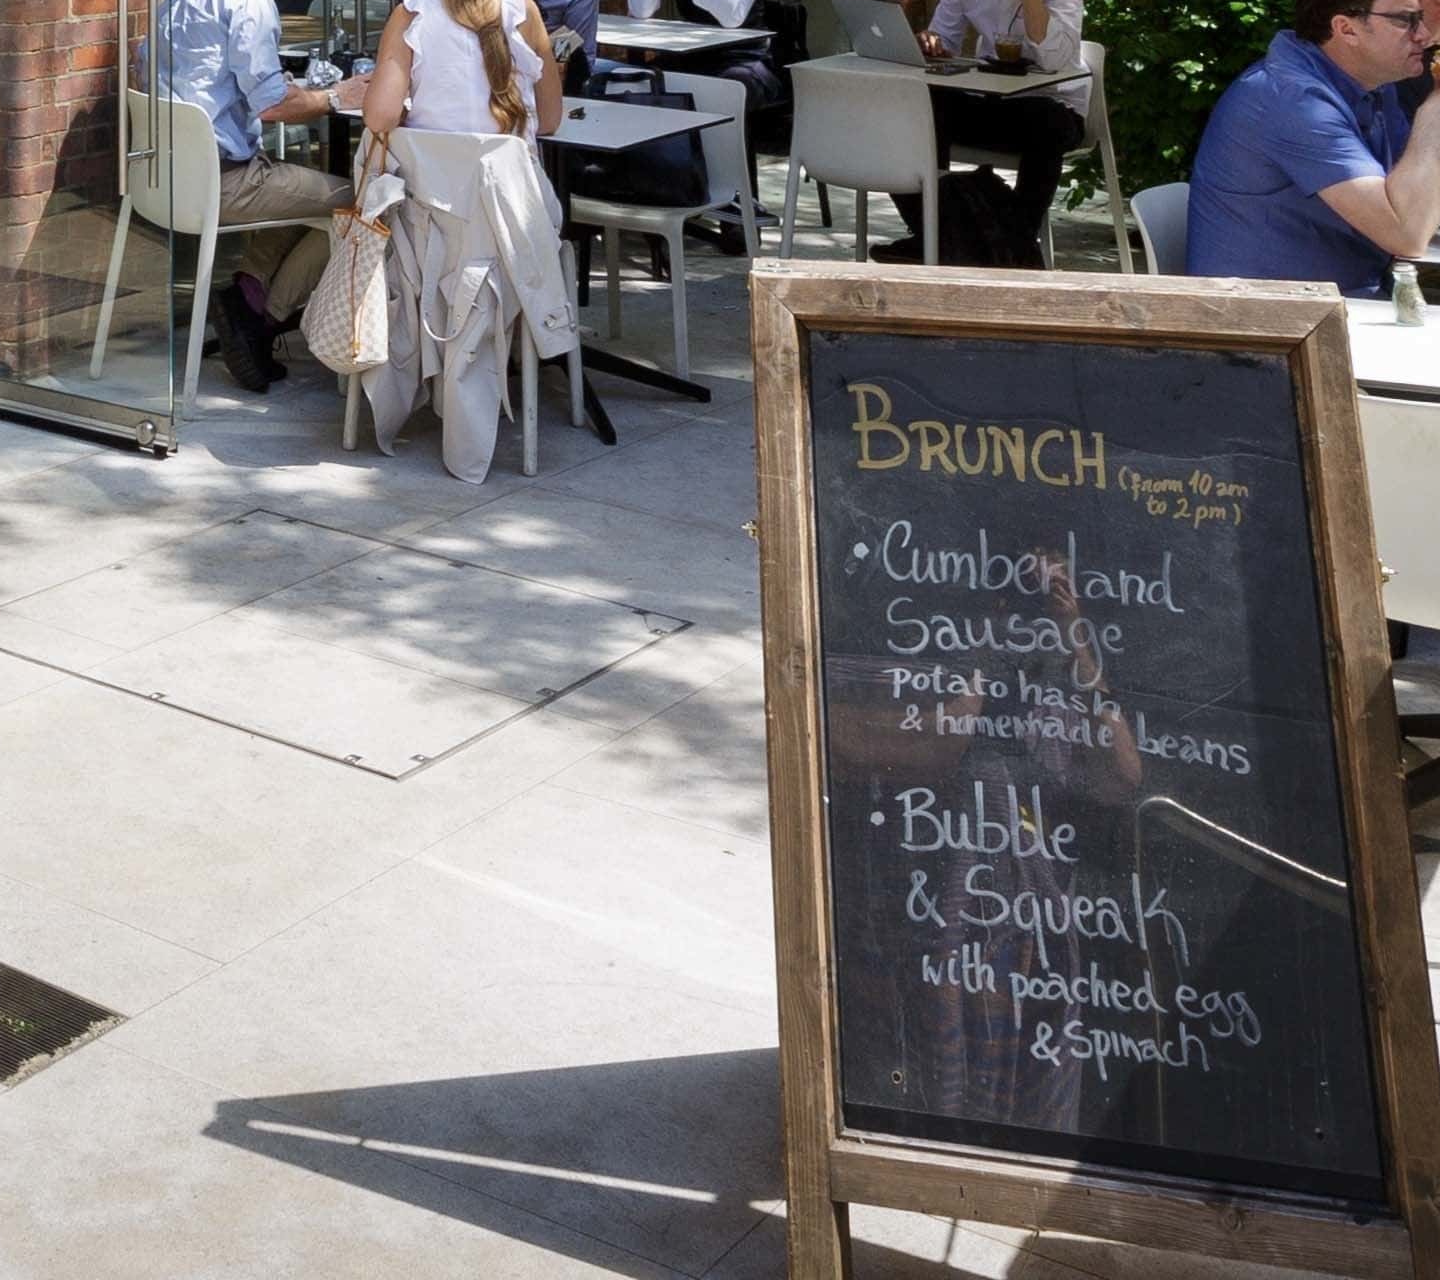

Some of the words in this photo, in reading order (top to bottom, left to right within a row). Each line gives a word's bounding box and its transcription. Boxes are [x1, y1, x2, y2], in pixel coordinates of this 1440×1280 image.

[848, 383, 1107, 489] BRUNCH
[1146, 496, 1168, 516] to
[1173, 499, 1191, 519] 2
[1187, 469, 1211, 498] 10
[1215, 481, 1249, 498] am
[882, 520, 1185, 613] Cumberland
[887, 597, 1125, 689] Sausage
[1019, 670, 1121, 721] hash
[898, 704, 923, 732] &
[936, 702, 1115, 748] homemade
[1135, 712, 1251, 775] beans
[895, 781, 1079, 863] Bubble
[906, 870, 947, 928] &
[922, 941, 997, 994] with
[1009, 961, 1168, 1030] poached
[1175, 983, 1262, 1046] egg
